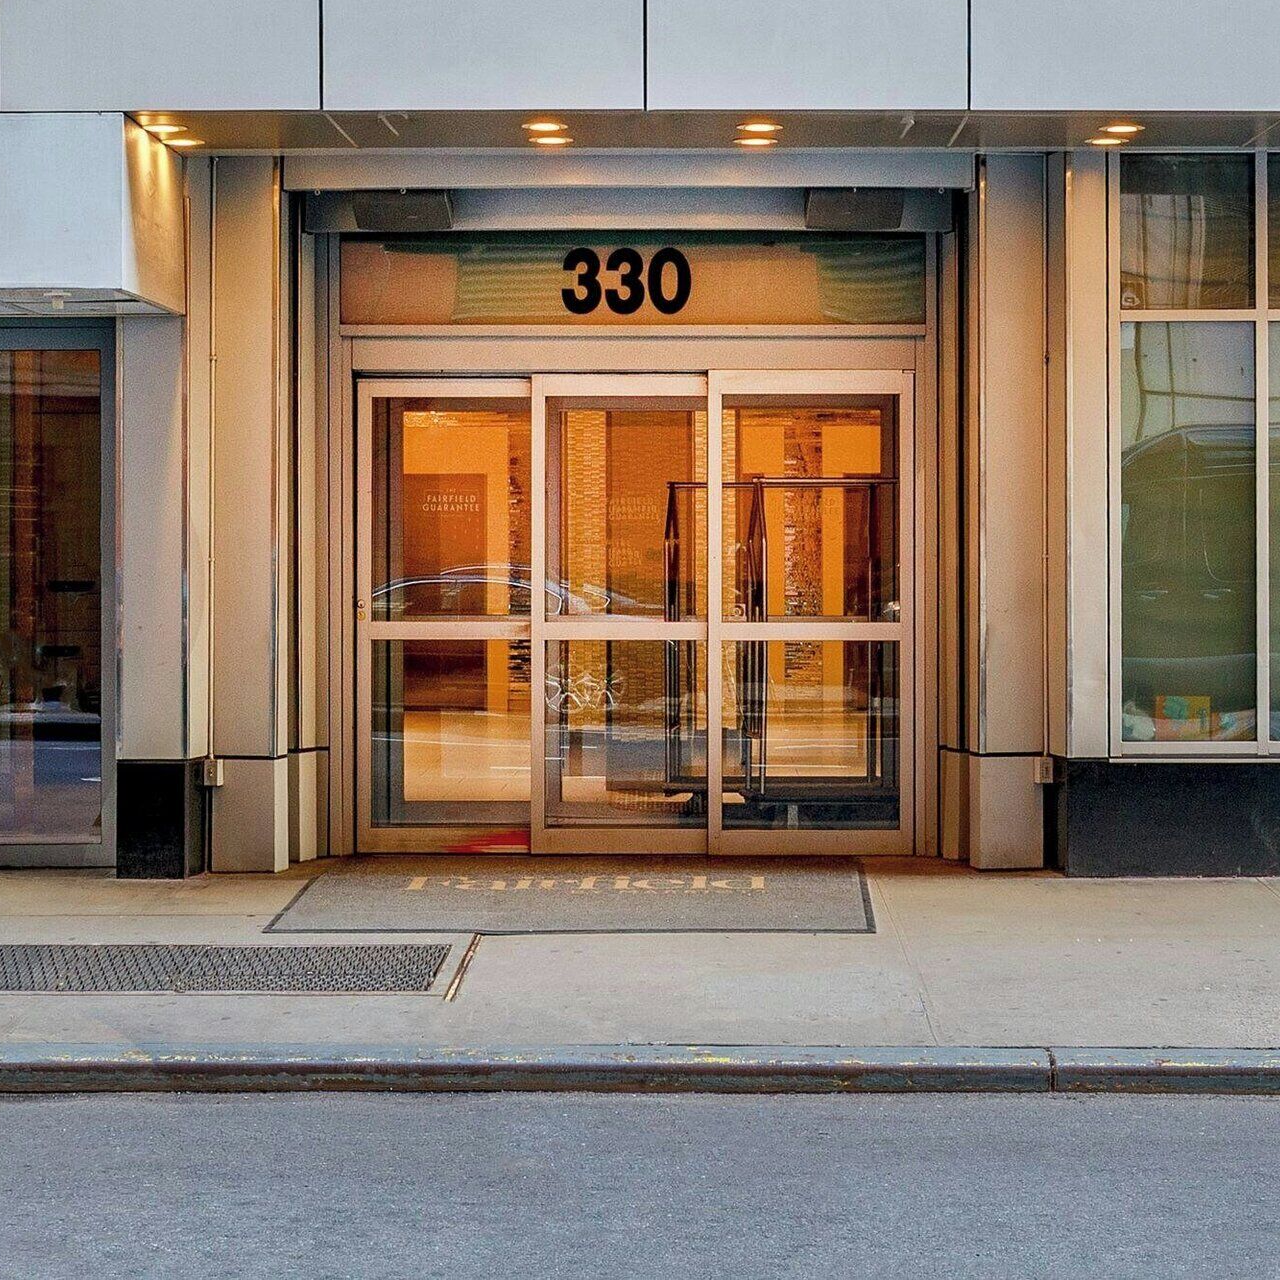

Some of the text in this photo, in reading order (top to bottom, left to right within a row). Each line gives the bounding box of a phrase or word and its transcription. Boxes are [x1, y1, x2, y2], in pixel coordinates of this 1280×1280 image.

[561, 247, 692, 315] 330
[426, 494, 477, 503] FAIRFIELD
[422, 503, 480, 512] GUARANTEE
